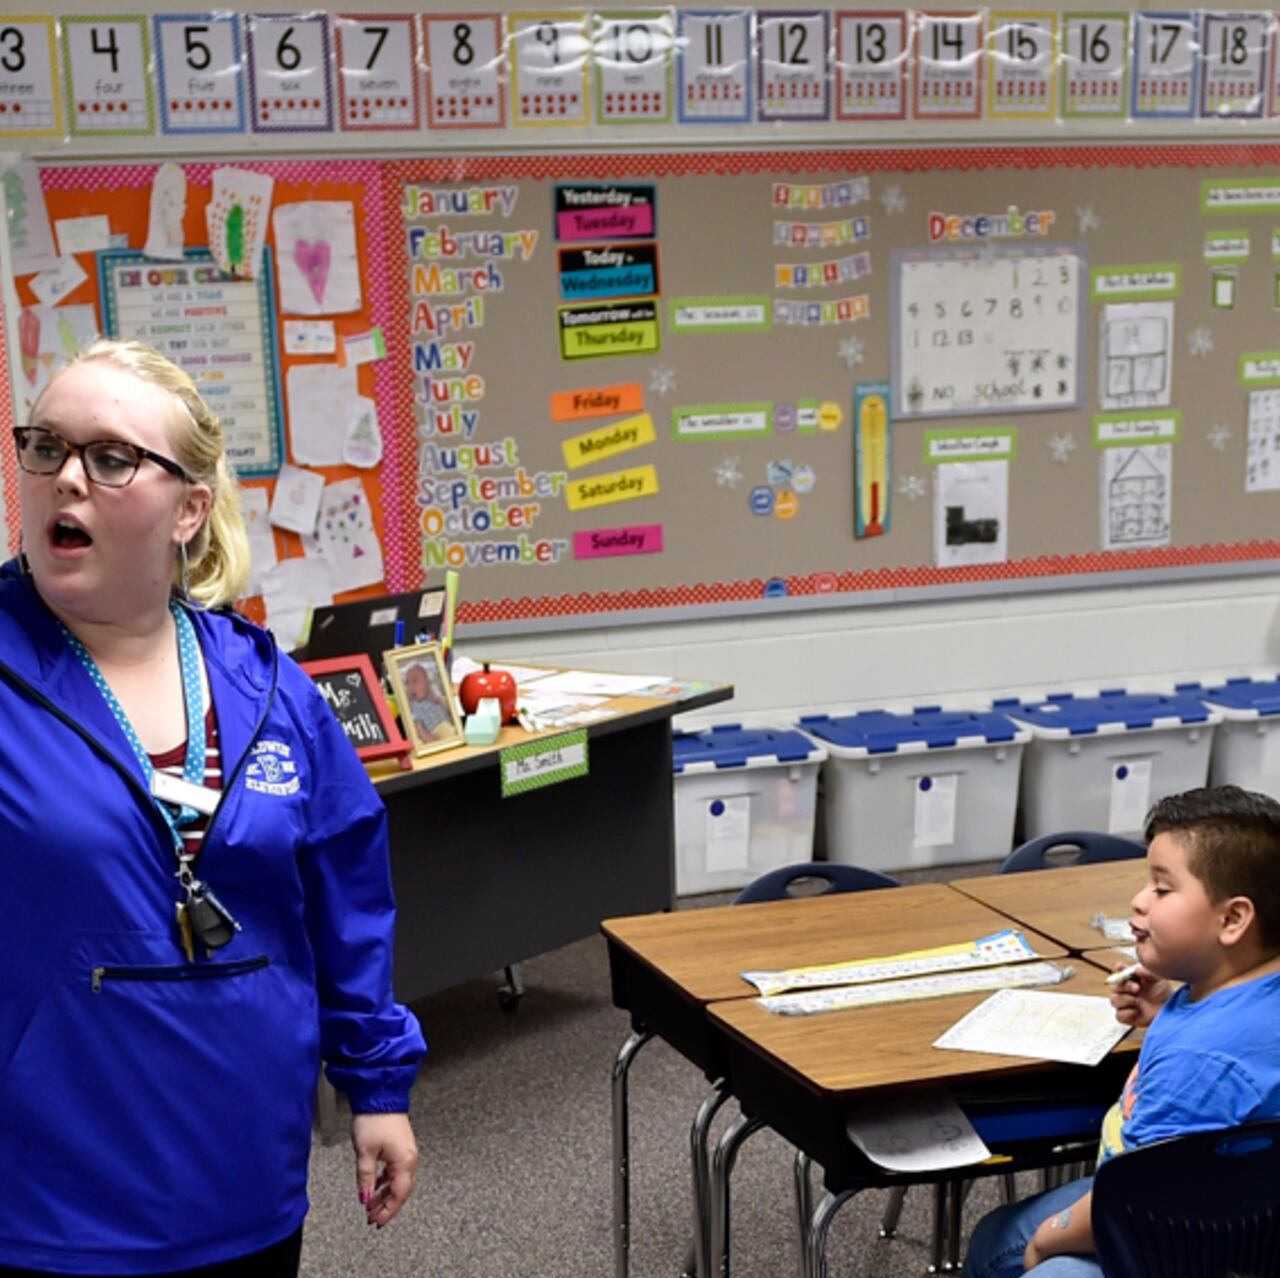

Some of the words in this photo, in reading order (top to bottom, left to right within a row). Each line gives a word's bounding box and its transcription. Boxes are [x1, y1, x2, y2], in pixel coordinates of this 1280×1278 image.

[91, 29, 119, 72] 4
[184, 28, 211, 71] 5
[276, 28, 301, 71] 6
[363, 28, 389, 71] 7
[453, 24, 475, 65] 8
[536, 21, 560, 64] 9
[613, 24, 654, 64] 10
[704, 24, 723, 65] 11
[778, 24, 810, 65] 12
[855, 23, 887, 64] 13
[932, 22, 964, 61] 14
[1007, 23, 1038, 62] 15
[1079, 24, 1111, 65] 16
[1150, 25, 1182, 64] 17
[1220, 26, 1248, 65] 18
[94, 80, 123, 93] four
[187, 80, 215, 93] five
[279, 80, 301, 92] six
[359, 79, 399, 91] seven
[401, 185, 518, 219] January
[563, 189, 632, 207] Yesterday
[573, 214, 636, 231] Tuesday
[928, 206, 1055, 241] December
[408, 226, 539, 261] February
[582, 249, 625, 266] Today
[119, 269, 142, 287] IN
[147, 268, 190, 287] OUR
[413, 261, 504, 295] March
[561, 272, 651, 292] Wednesday
[414, 296, 484, 339] April
[561, 308, 631, 325] Tomorrow
[961, 300, 973, 318] 6
[985, 298, 998, 315] 7
[1010, 298, 1024, 318] 8
[575, 328, 644, 346] Thursday
[414, 341, 473, 372] May
[418, 374, 485, 404] June
[573, 393, 621, 410] Friday
[933, 384, 956, 399] NO
[421, 404, 479, 439] July
[422, 437, 519, 474] August
[578, 427, 638, 455] Monday
[417, 468, 568, 511] September
[577, 475, 644, 500] Saturday
[420, 502, 541, 537] October
[423, 535, 568, 569] November
[590, 531, 645, 549] Sunday
